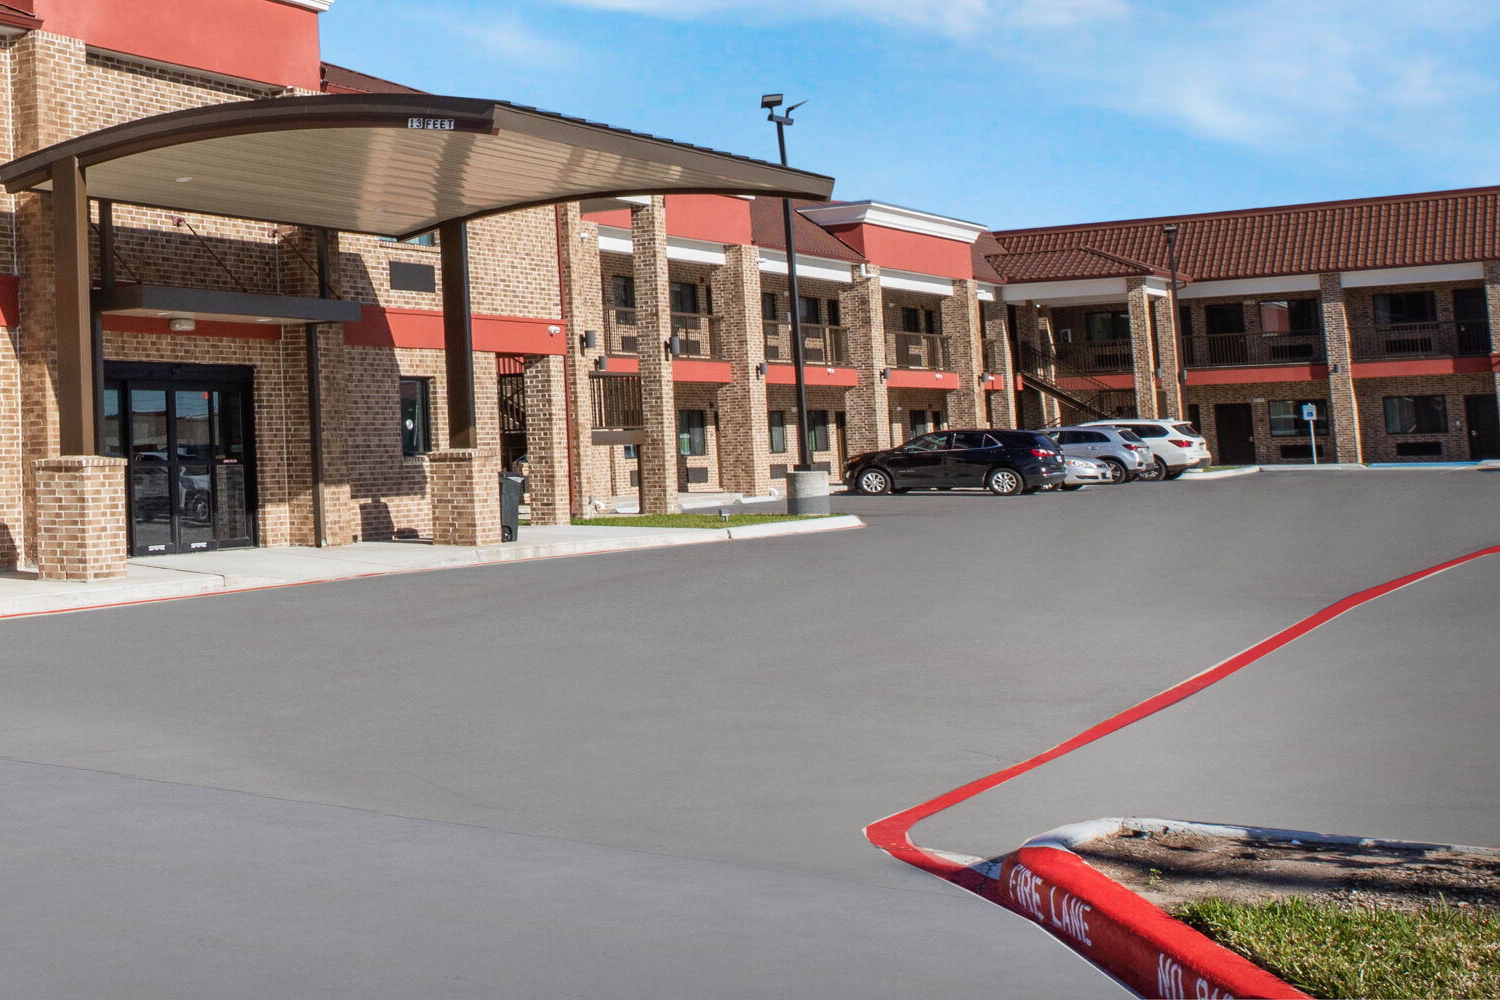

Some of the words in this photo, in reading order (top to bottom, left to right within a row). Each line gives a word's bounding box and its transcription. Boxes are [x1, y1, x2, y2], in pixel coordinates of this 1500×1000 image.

[410, 118, 422, 128] 13
[426, 119, 454, 129] FEET
[1008, 863, 1045, 921] FIRE
[1049, 885, 1093, 947] LANE
[1157, 952, 1184, 1000] NO
